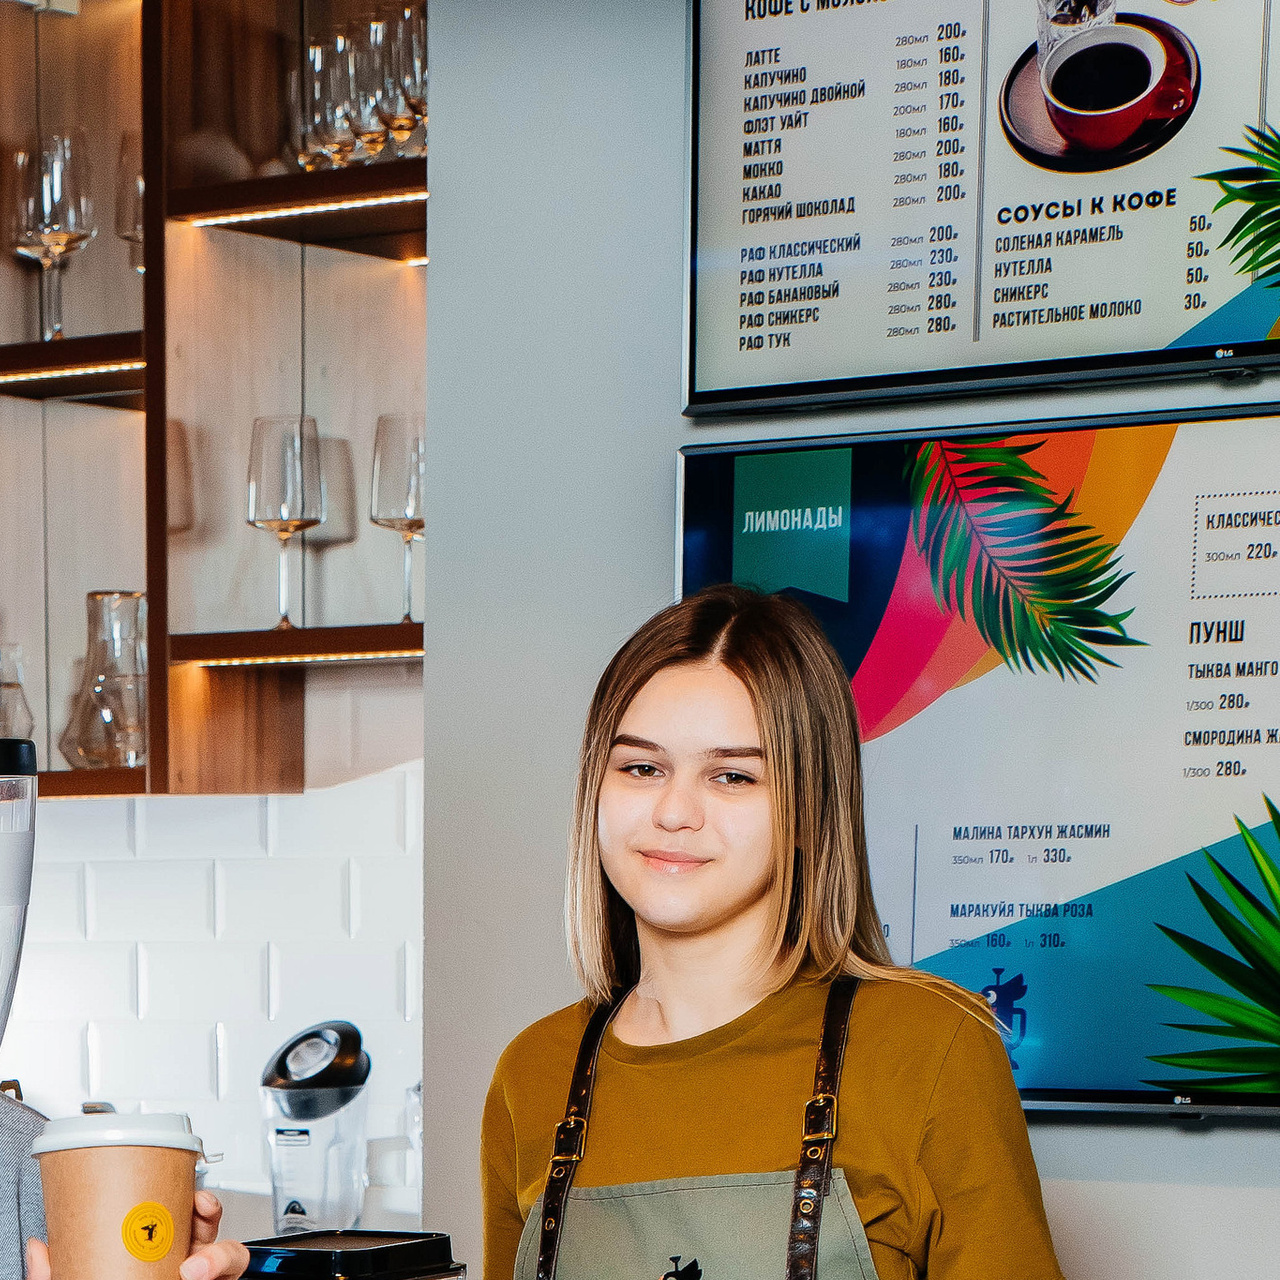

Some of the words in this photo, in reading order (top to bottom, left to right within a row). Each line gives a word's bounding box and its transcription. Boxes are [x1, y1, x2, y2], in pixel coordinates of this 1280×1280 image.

[745, 47, 781, 68] ЛАТТЕ
[895, 34, 929, 47] 280мл
[744, 66, 807, 90] КАПУЧИНО
[896, 58, 928, 70] 180мл
[744, 89, 806, 113] КАПУЧИНО
[810, 79, 866, 105] ДВОЙНОЙ
[894, 81, 928, 93] 280мл
[743, 116, 775, 135] ФЛЭТ
[780, 110, 810, 131] УАЙТ
[893, 104, 926, 117] 200мл
[742, 138, 782, 158] МАТТЯ
[895, 127, 926, 139] 180мл
[742, 160, 783, 180] МОККО
[893, 150, 926, 162] 280мл
[742, 183, 782, 202] КАКАО
[893, 173, 927, 185] 280мл
[742, 201, 793, 225] ГОРЯЧИЙ
[795, 196, 856, 219] ШОКОЛАД
[892, 196, 926, 208] 280мл
[996, 198, 1082, 225] СОУСЫ
[1090, 195, 1105, 215] К
[1111, 187, 1177, 214] КОФЕ
[740, 246, 766, 263] РАФ
[769, 233, 861, 261] КЛАССИЧЕСКИЙ
[890, 236, 924, 247] 280мл
[995, 230, 1052, 253] СОЛЕНАЯ
[1055, 224, 1124, 247] КАРАМЕЛЬ
[740, 268, 766, 286] РАФ
[768, 262, 823, 283] НУТЕЛЛА
[889, 258, 923, 270] 280мл
[994, 257, 1053, 279] НУТЕЛЛА
[739, 290, 765, 308] РАФ
[768, 280, 840, 305] БАНАНОВЫЙ
[887, 281, 920, 293] 280мл
[993, 283, 1049, 304] СНИКЕРС
[739, 312, 765, 330] РАФ
[767, 307, 820, 327] СНИКЕРС
[888, 303, 921, 315] 280мл
[992, 303, 1086, 329] РАСТИТЕЛЬНОЕ
[1089, 299, 1142, 320] МОЛОКО
[739, 335, 764, 352] РАФ
[767, 332, 792, 349] ТУК
[886, 326, 920, 338] 280мл
[742, 506, 843, 534] ЛИМОНАДЫ
[1204, 551, 1241, 563] 300мл
[1188, 620, 1245, 645] ПУНШ
[1188, 662, 1232, 679] ТЫКВА
[1235, 660, 1279, 677] МАНГО
[1186, 700, 1214, 711] 1/300
[1184, 729, 1261, 746] СМОРОДИНА
[1182, 767, 1211, 778] 1/300
[952, 825, 1003, 841] МАЛИНА
[1007, 824, 1052, 840] ТАРХУН
[1056, 823, 1111, 840] ЖАСМИН
[950, 900, 1014, 918] МАРАКУЙЯ
[1018, 903, 1059, 918] ТЫКВА
[1062, 903, 1094, 918] РОЗА
